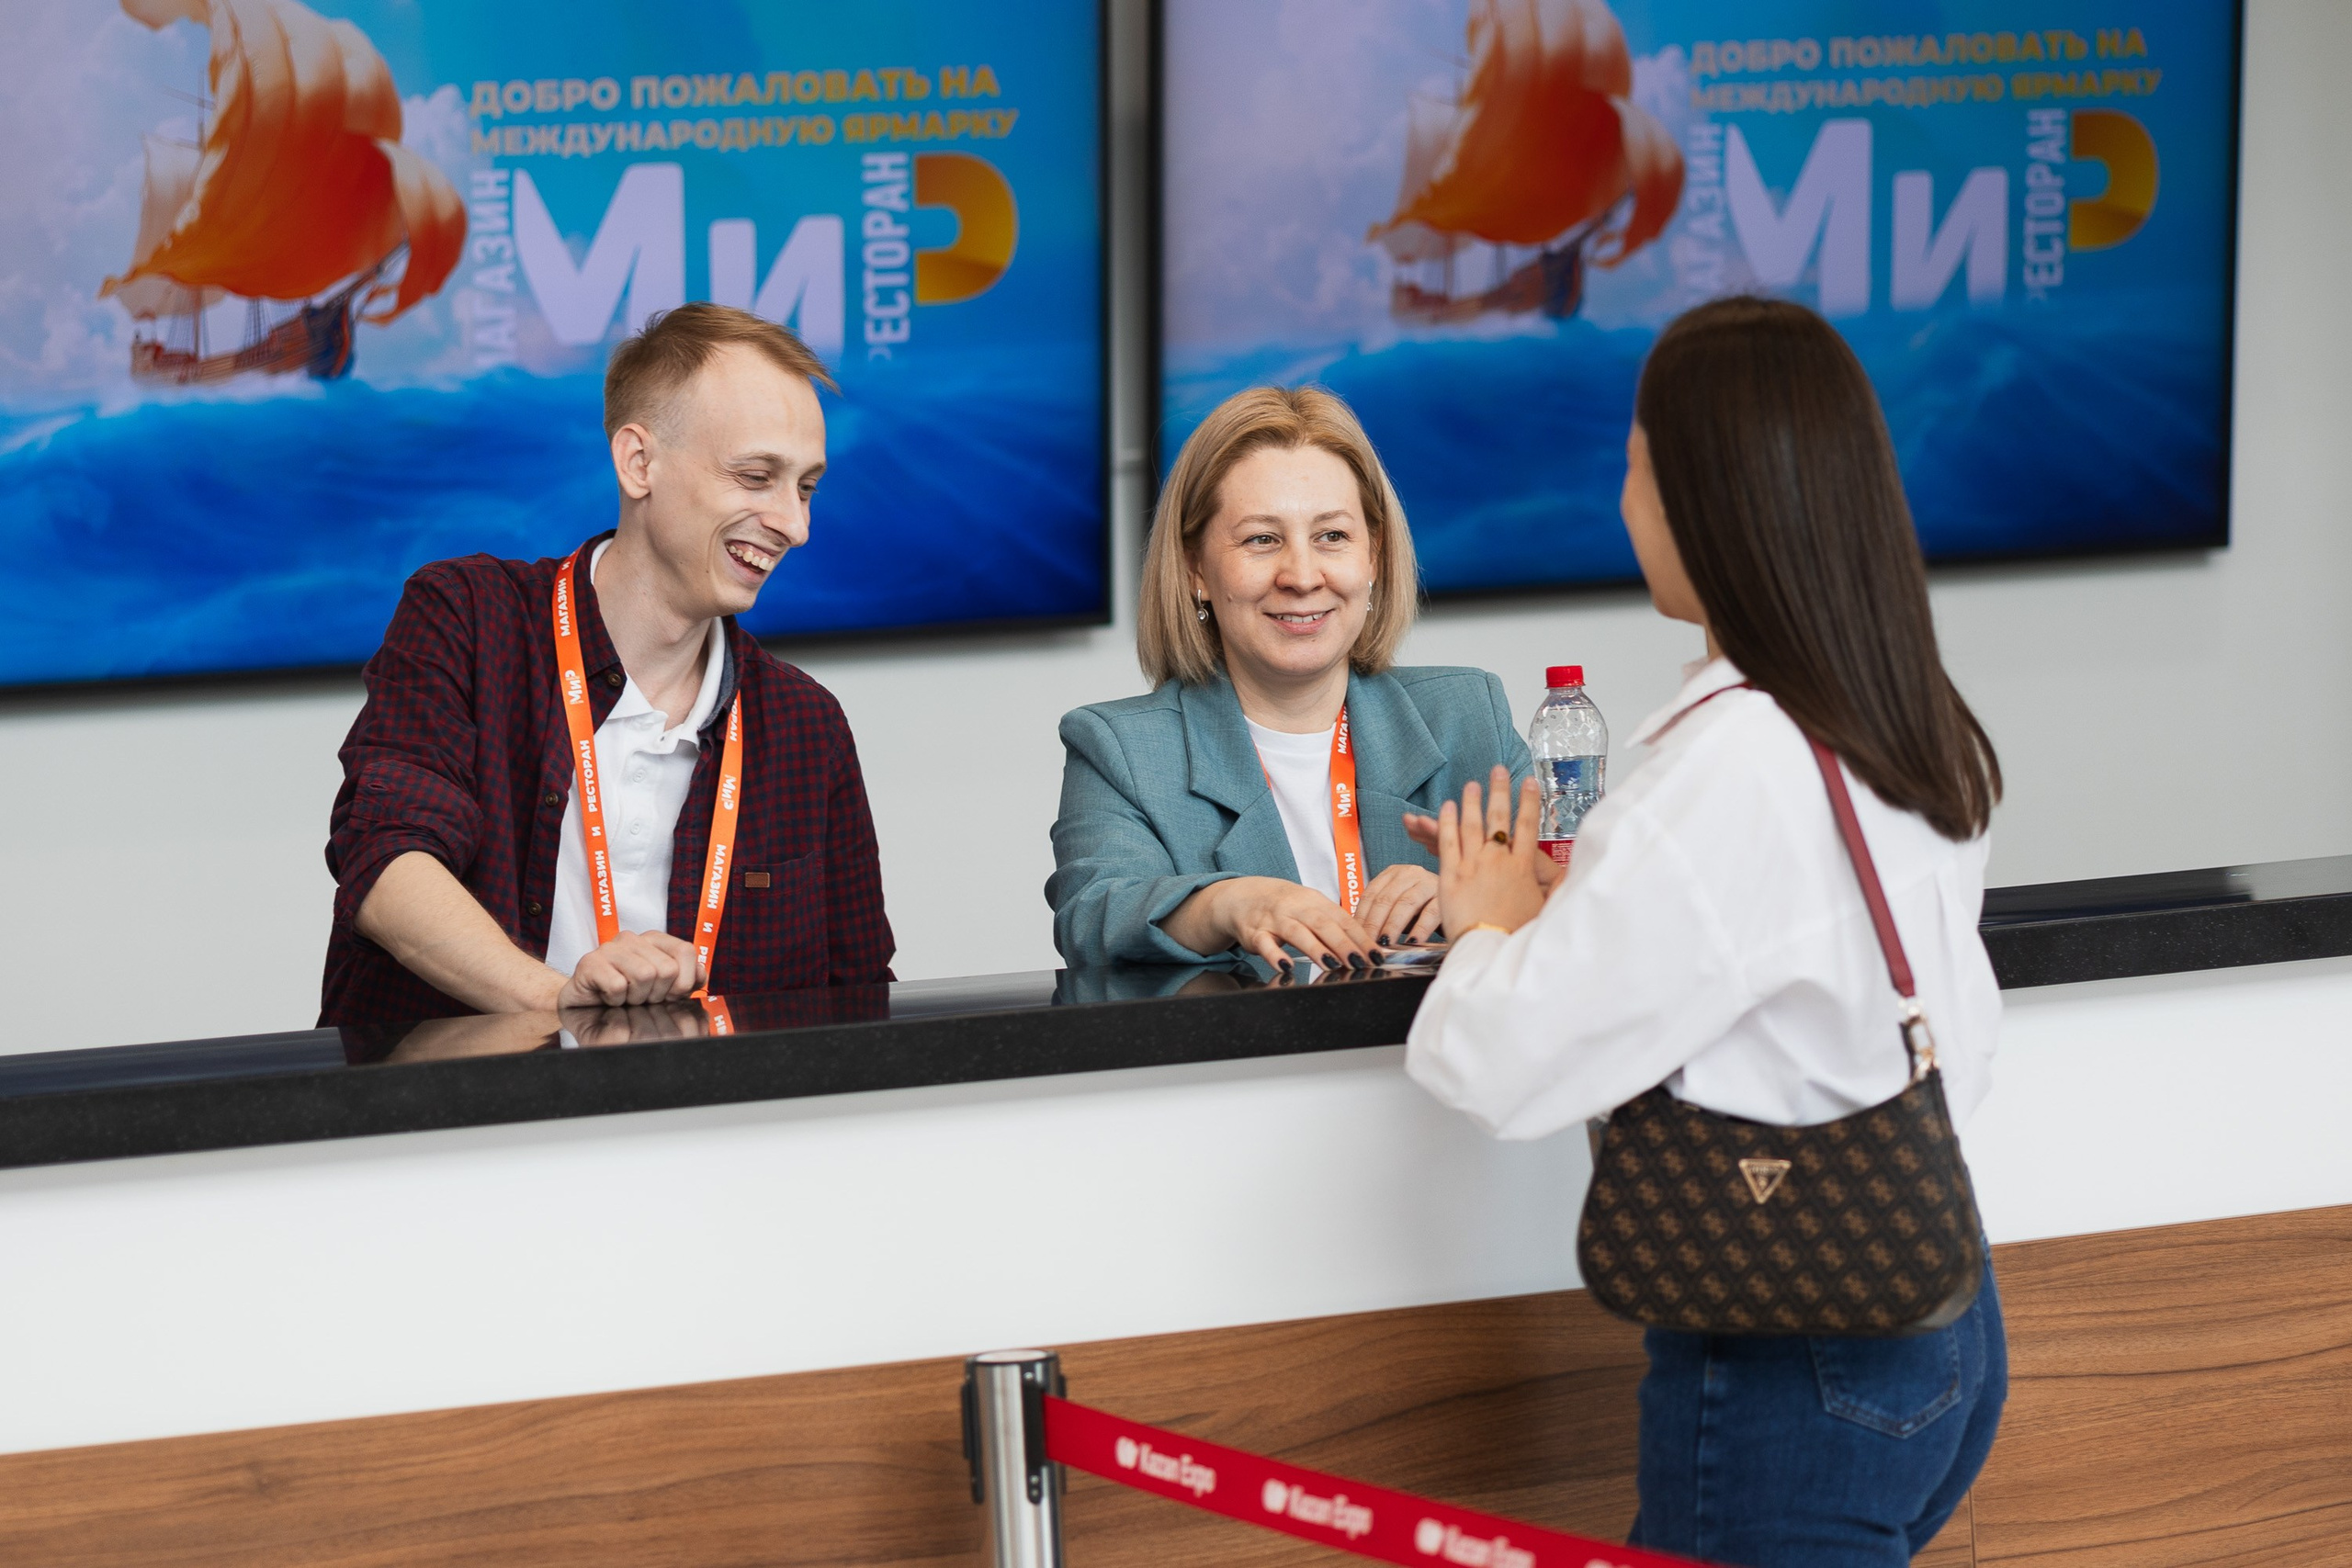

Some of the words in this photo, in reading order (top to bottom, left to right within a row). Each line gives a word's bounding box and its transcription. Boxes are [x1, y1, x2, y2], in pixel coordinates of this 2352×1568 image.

[1690, 39, 1822, 79] ДОБРО
[1828, 30, 2088, 69] ПОЖАЛОВАТЬ
[2096, 27, 2148, 60] НА
[469, 77, 621, 119] ДОБРО
[629, 68, 932, 110] ПОЖАЛОВАТЬ
[939, 63, 1001, 99] НА
[1690, 73, 2005, 115] МЕЖДУНАРОДНУЮ
[2009, 67, 2164, 101] ЯРМАРКУ
[470, 114, 836, 159] МЕЖДУНАРОДНУЮ
[842, 107, 1020, 144] ЯРМАРКУ
[558, 578, 571, 637] МАГАЗИН
[579, 739, 598, 813] РЕСТОРАН
[592, 826, 602, 837] И
[594, 850, 613, 917] МАГАЗИН
[707, 843, 727, 909] МАГАЗИН
[1344, 852, 1361, 918] ЕСТОРАН
[702, 921, 714, 933] И
